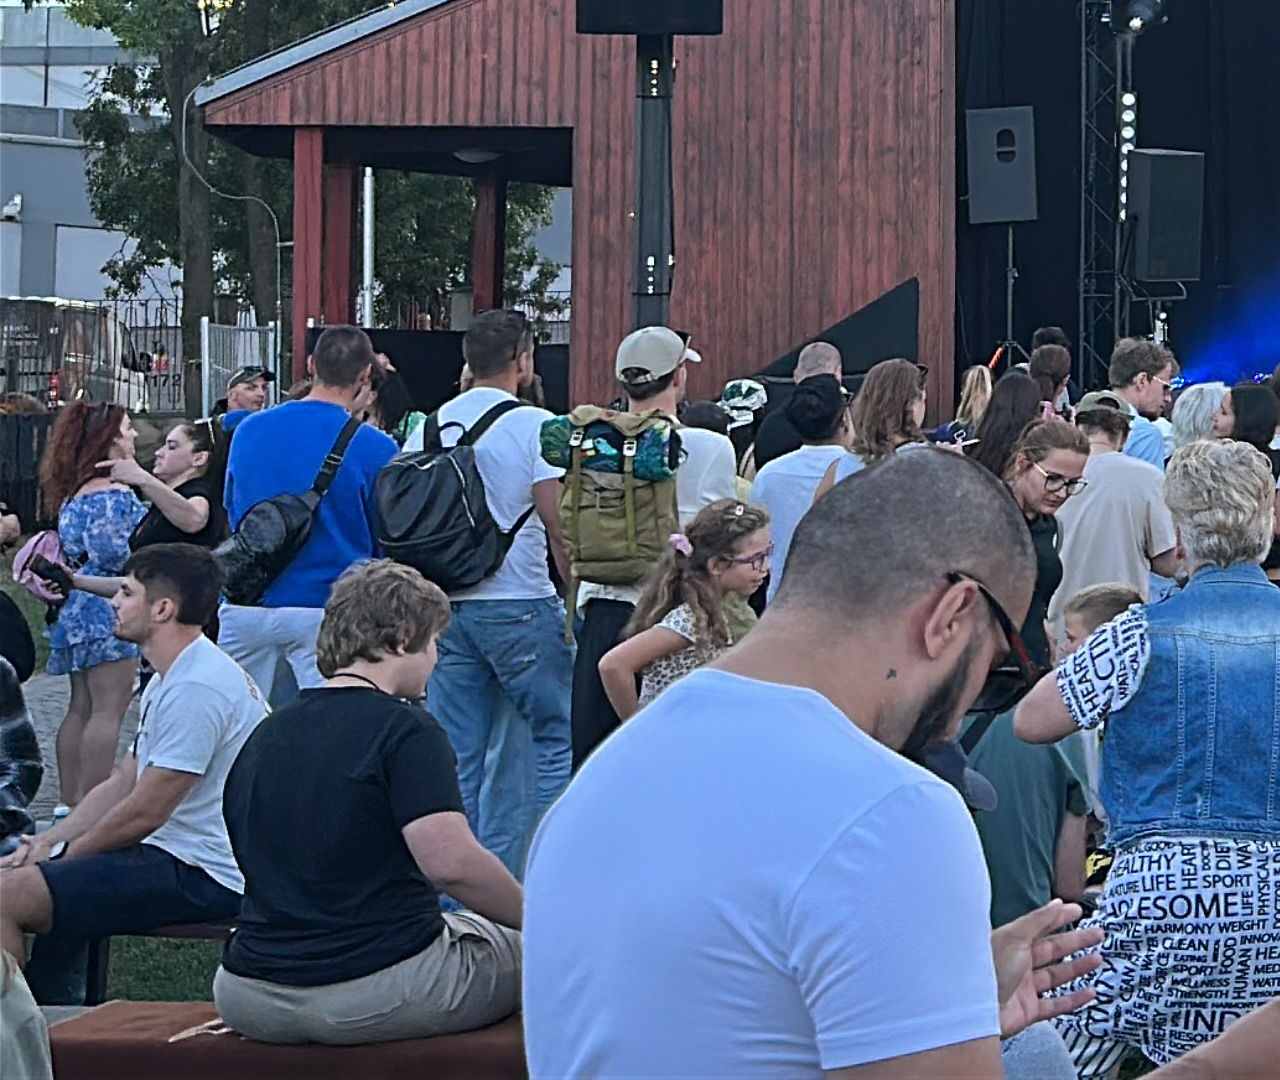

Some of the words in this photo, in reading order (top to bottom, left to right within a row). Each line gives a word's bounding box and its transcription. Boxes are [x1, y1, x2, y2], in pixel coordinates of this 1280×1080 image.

[1141, 873, 1177, 893] LIFE
[1202, 873, 1254, 889] SPORT
[1257, 855, 1271, 916] PHYSICAL
[1240, 889, 1255, 917] LIFE
[1144, 921, 1215, 935] HARMONY
[1217, 918, 1269, 934] WEIGHT
[1162, 937, 1209, 952] CLEAN
[1218, 937, 1238, 975] FOOD
[1171, 963, 1218, 977] SPORT
[1231, 948, 1253, 1000] HUMAN
[1170, 976, 1231, 989] WELLNESS
[1167, 986, 1230, 1000] STRENGTH
